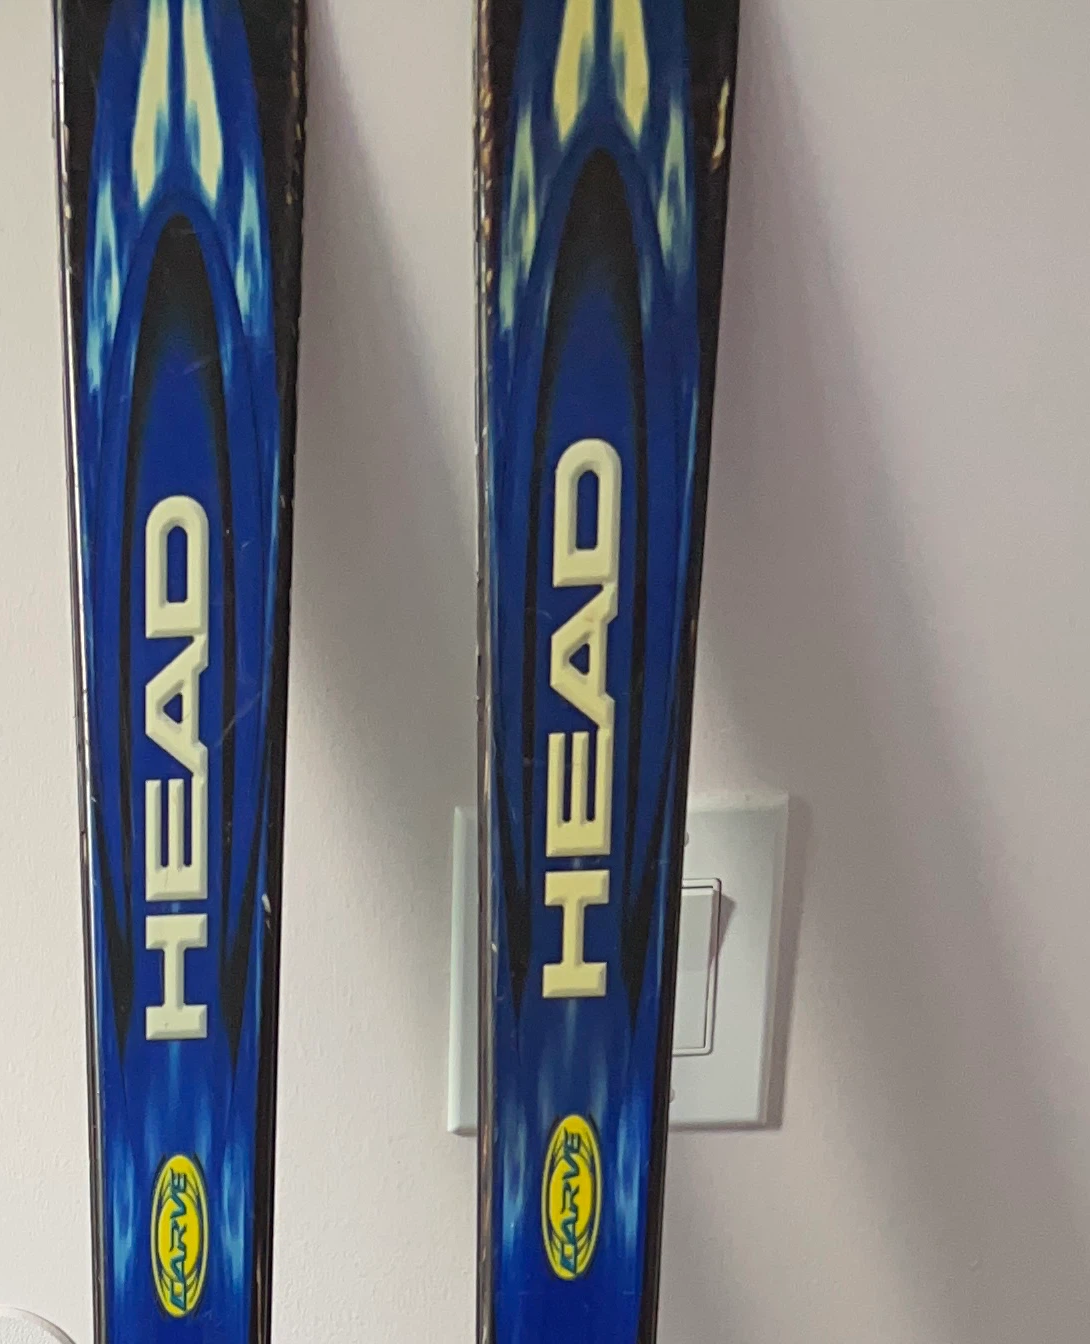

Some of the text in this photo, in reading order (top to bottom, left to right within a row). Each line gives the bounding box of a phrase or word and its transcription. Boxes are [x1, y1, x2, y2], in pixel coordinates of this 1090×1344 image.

[145, 495, 209, 1041] HEAD
[541, 438, 621, 998] HEAD
[170, 1168, 188, 1312] CARVE
[560, 1128, 582, 1276] CARVE
